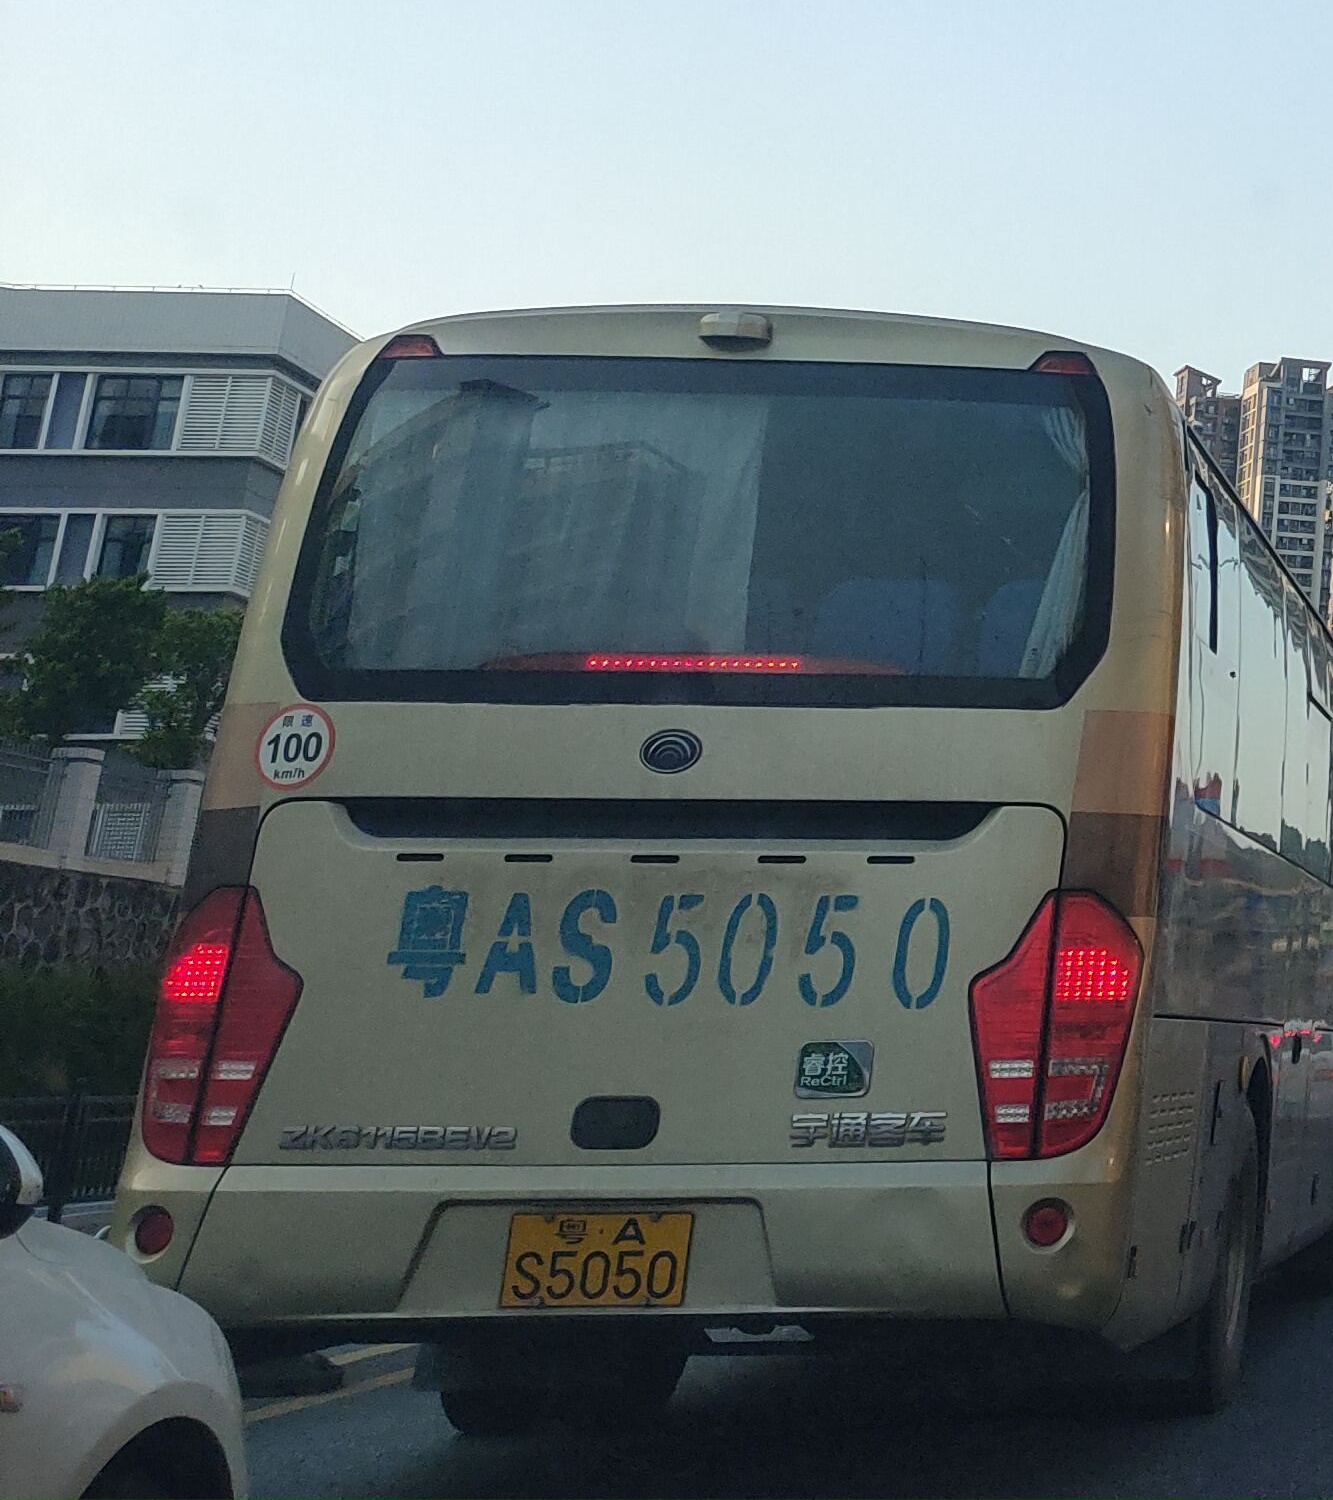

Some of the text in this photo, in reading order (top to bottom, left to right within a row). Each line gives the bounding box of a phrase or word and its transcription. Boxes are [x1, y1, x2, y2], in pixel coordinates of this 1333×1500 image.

[282, 713, 315, 729] 限速
[266, 731, 323, 764] 100
[273, 767, 306, 781] km/h
[386, 884, 952, 1010] 粤AS5050
[802, 1051, 850, 1077] 睿控
[800, 1075, 848, 1087] ReCtrl
[279, 1124, 519, 1151] ZK6115BEV2
[789, 1111, 948, 1148] 宇通客车
[511, 1250, 678, 1300] S5050
